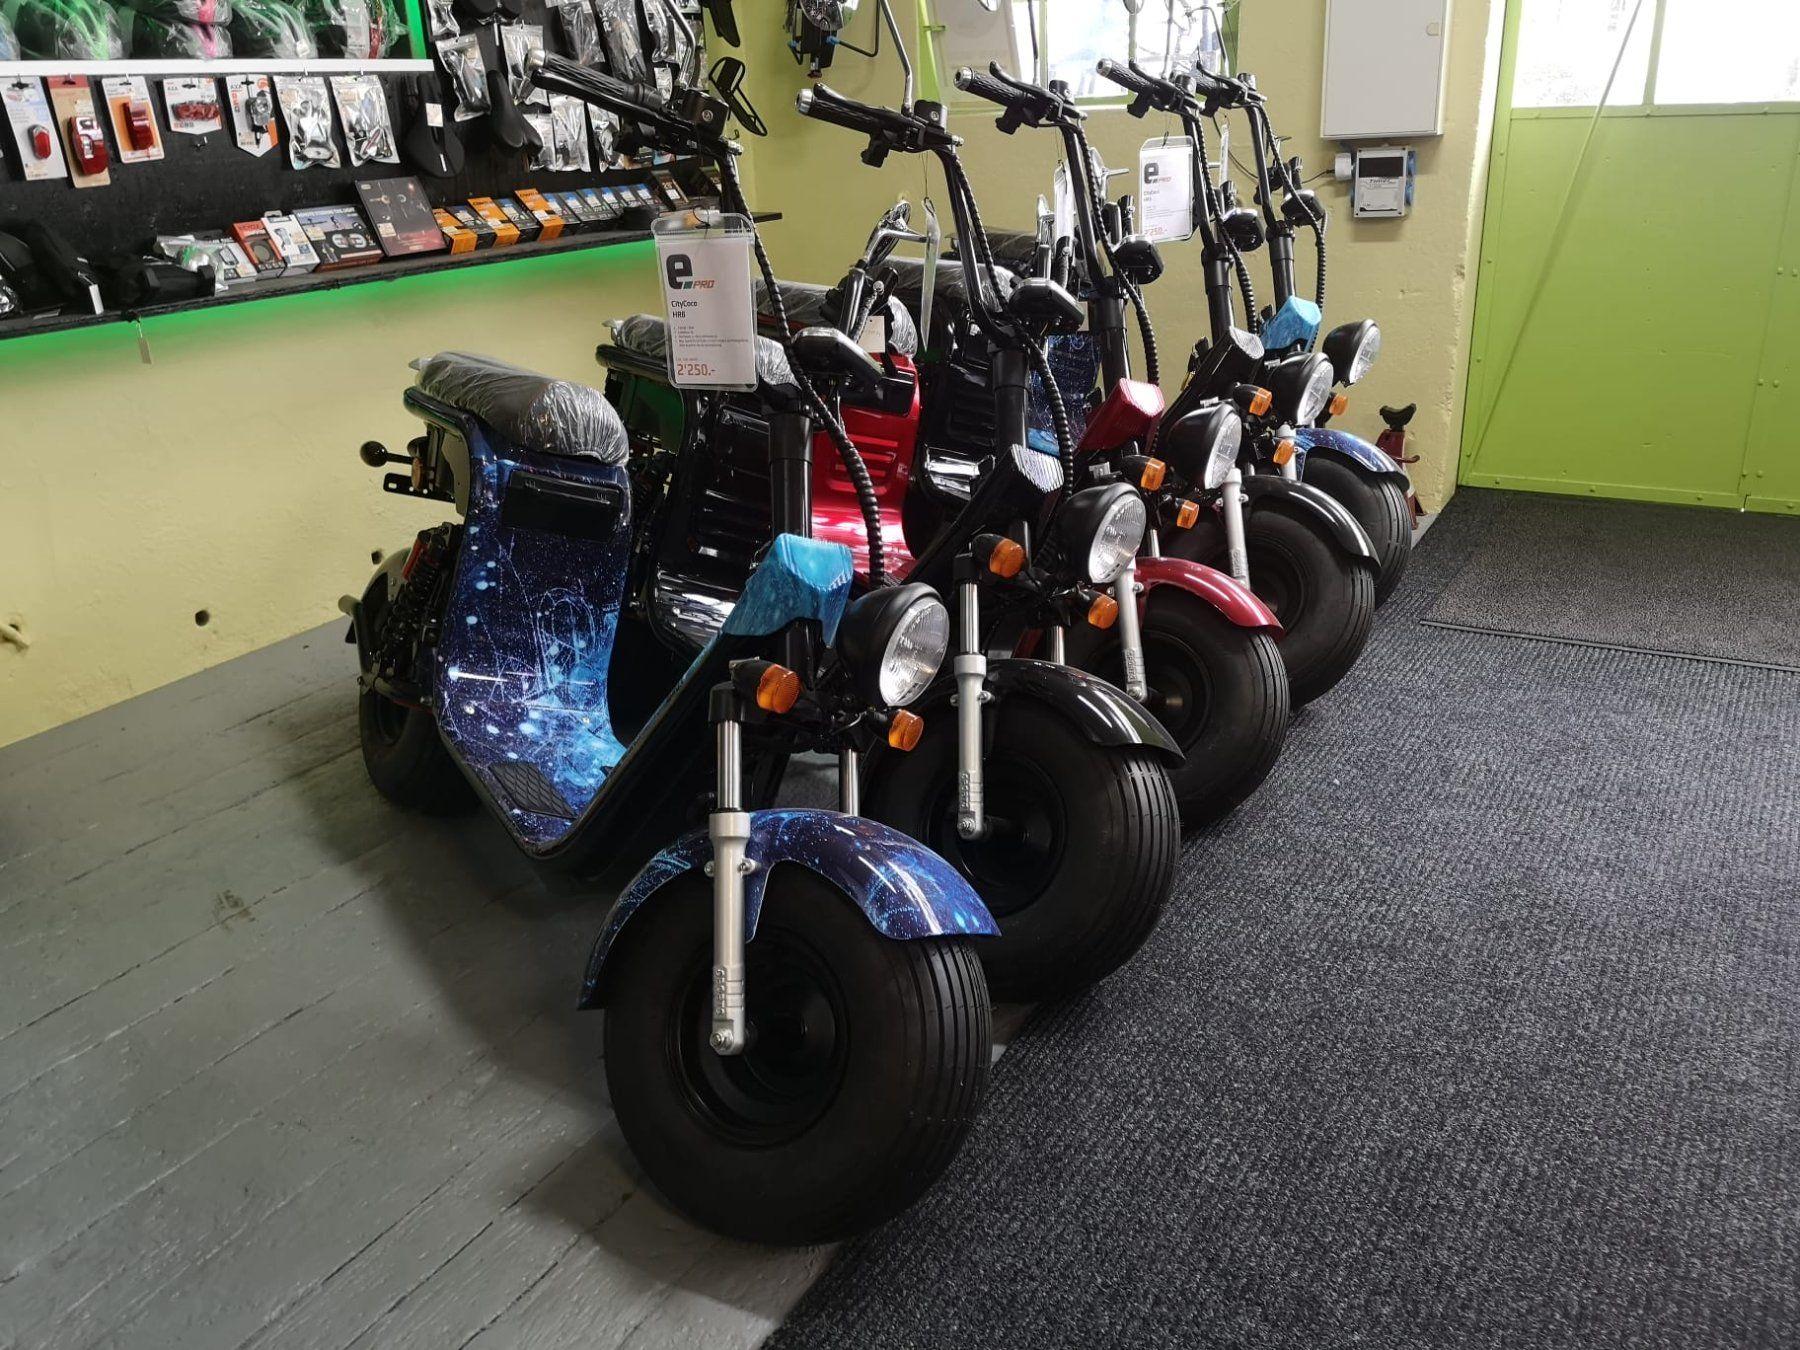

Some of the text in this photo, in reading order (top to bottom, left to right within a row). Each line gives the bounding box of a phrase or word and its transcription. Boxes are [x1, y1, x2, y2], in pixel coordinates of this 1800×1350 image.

[666, 254, 715, 289] e PRO
[671, 300, 697, 309] CityCoco
